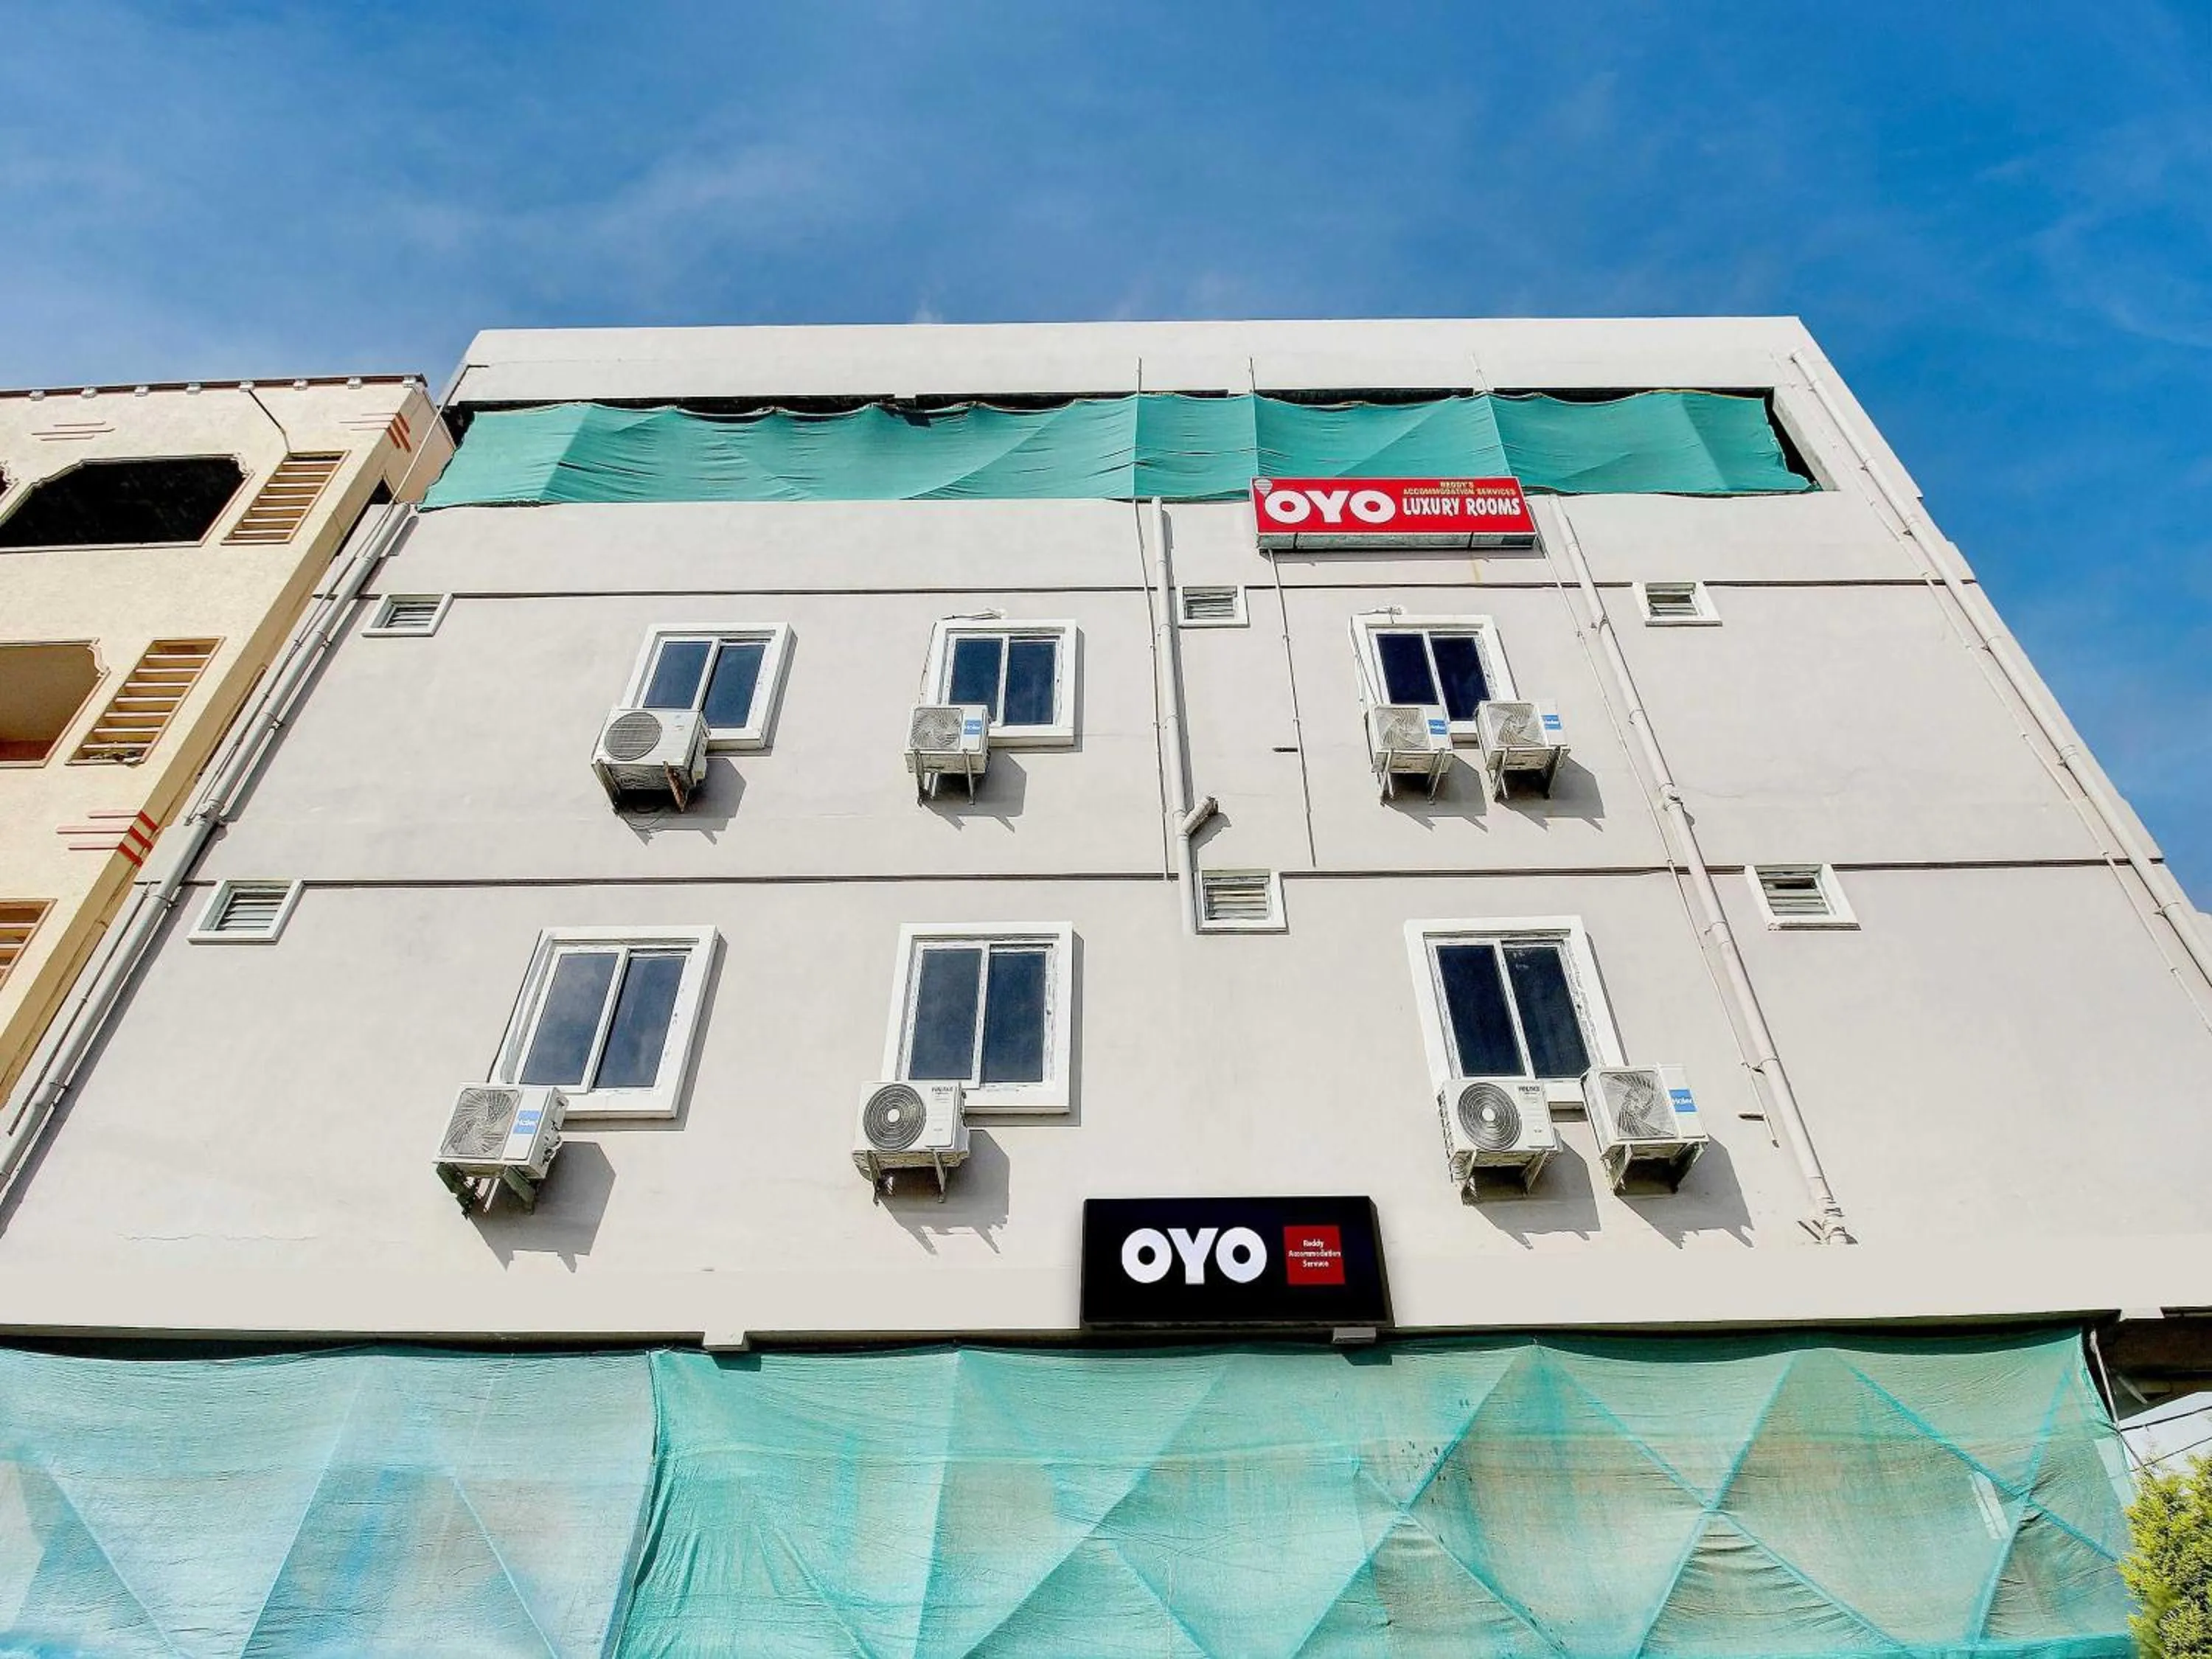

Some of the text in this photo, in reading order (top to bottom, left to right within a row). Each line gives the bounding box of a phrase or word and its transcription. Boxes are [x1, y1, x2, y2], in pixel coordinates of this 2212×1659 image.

[1265, 490, 1396, 523] OYO
[1402, 498, 1521, 516] LUXURY ROOMS
[1121, 1226, 1267, 1284] OYO
[1303, 1239, 1324, 1248] Reddy
